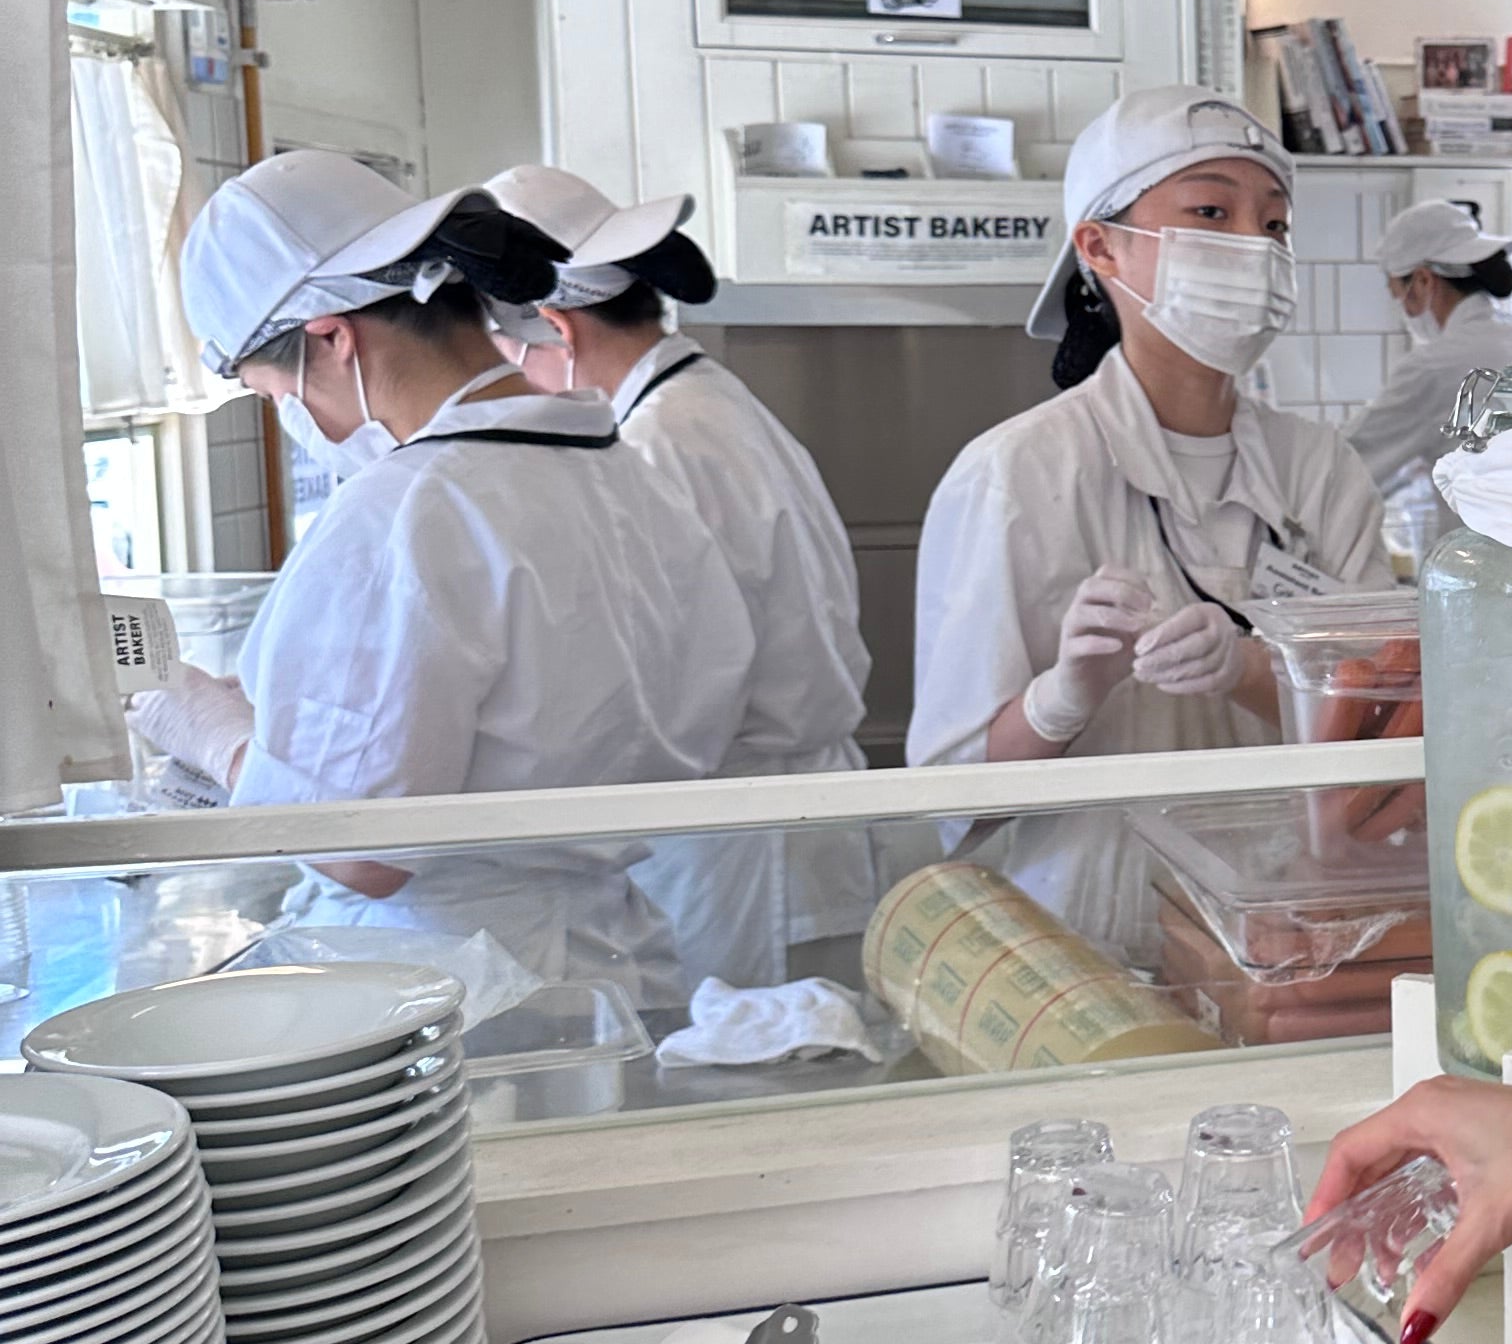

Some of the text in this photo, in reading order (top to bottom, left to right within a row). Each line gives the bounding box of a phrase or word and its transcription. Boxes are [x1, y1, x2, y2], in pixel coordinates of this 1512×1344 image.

[808, 214, 1051, 241] ARTIST BAKERY
[110, 614, 131, 667] ARTIST
[132, 616, 147, 666] BAKERY
